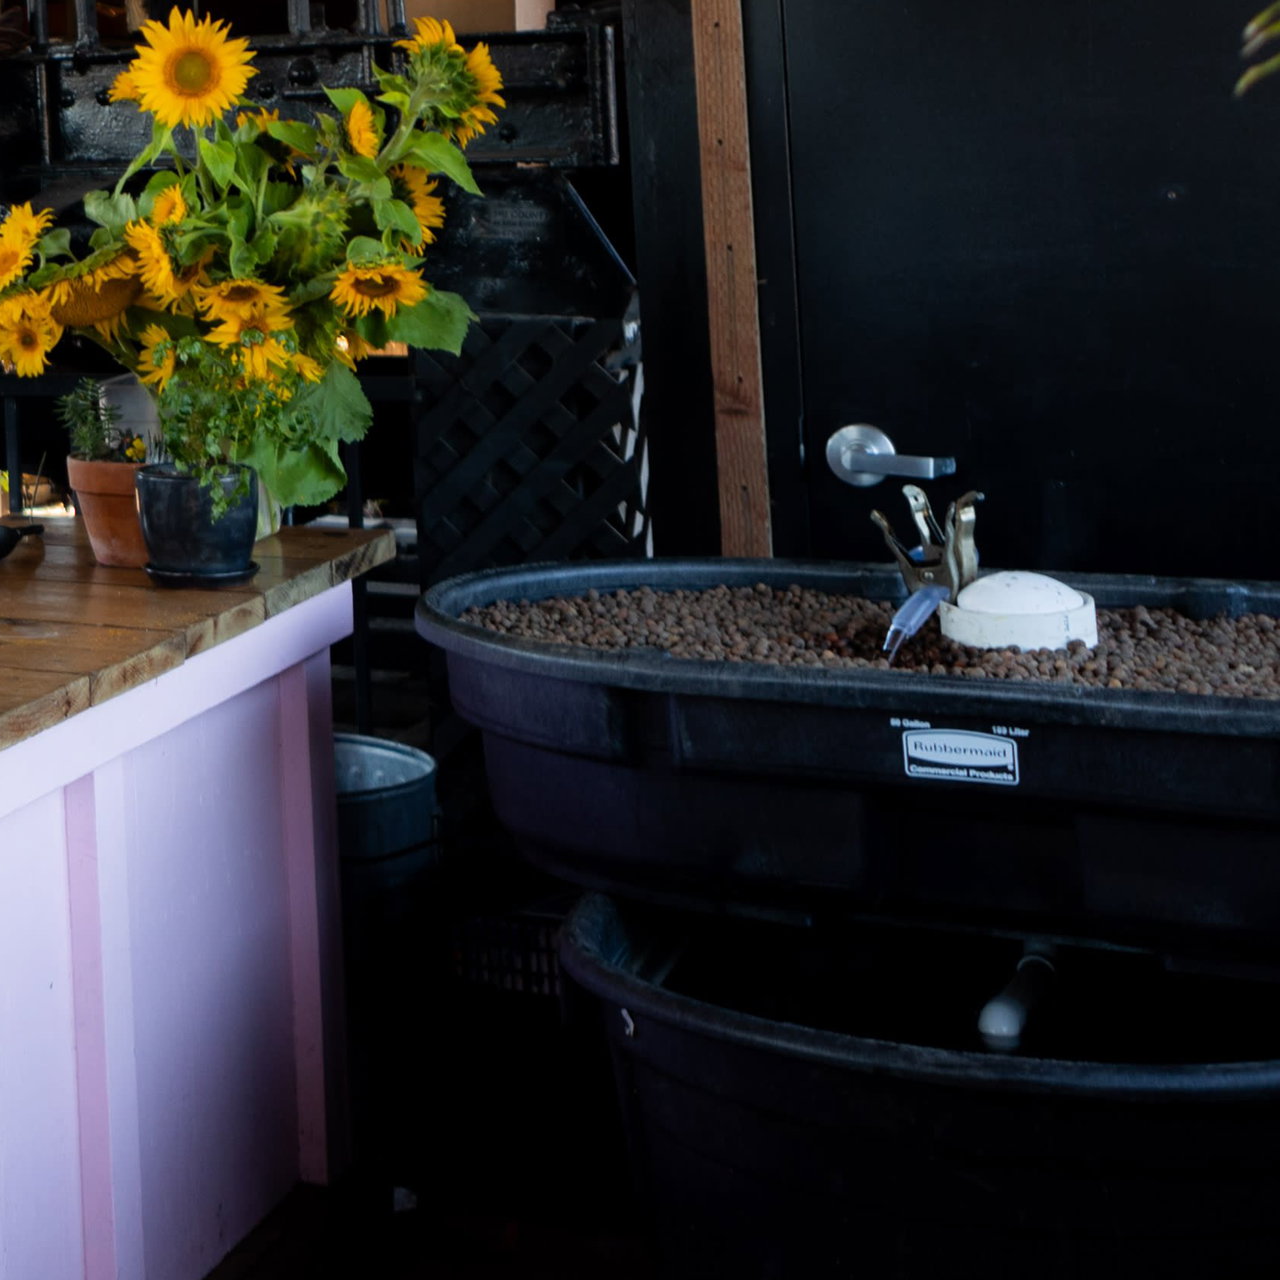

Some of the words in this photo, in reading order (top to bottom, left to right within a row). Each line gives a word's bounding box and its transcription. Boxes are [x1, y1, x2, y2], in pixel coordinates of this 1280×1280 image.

[902, 718, 931, 729] Gallon
[1008, 726, 1030, 737] Liter
[913, 740, 1007, 759] Rubbermaid
[909, 763, 968, 777] Commercial
[969, 768, 1014, 781] Products
